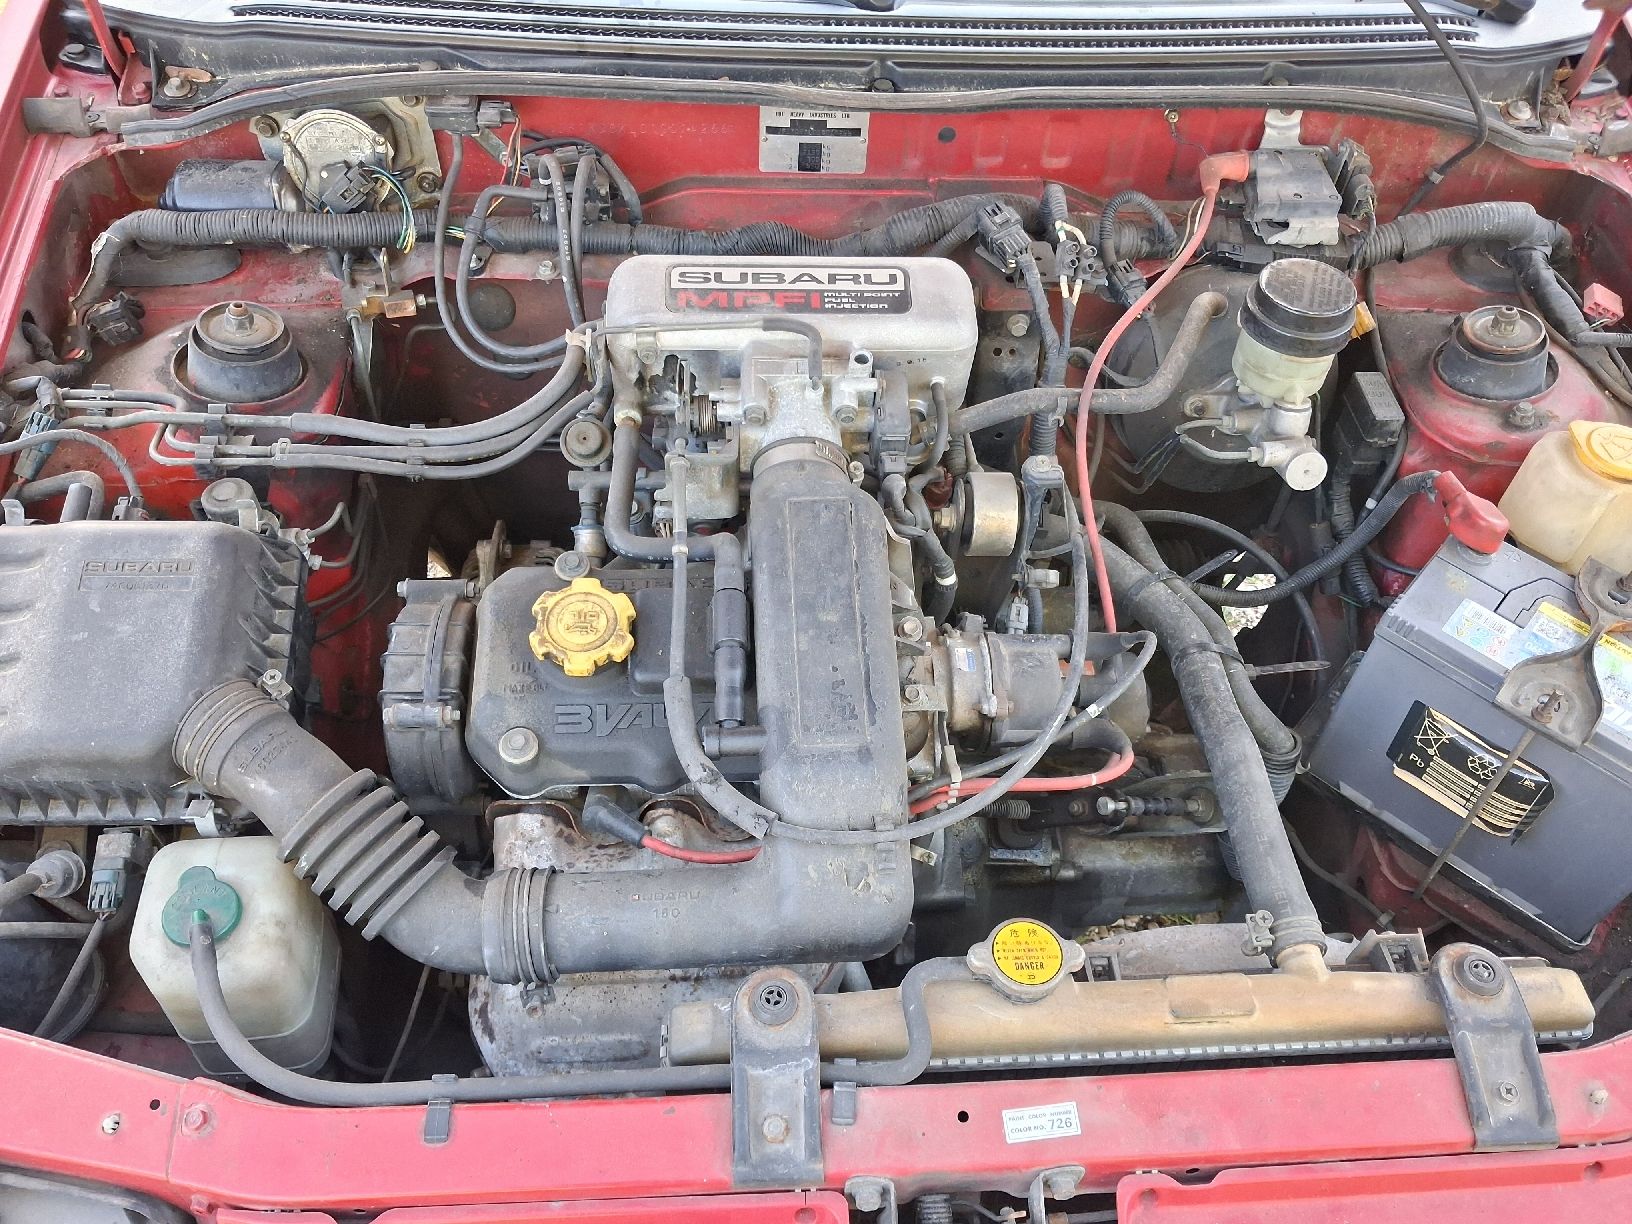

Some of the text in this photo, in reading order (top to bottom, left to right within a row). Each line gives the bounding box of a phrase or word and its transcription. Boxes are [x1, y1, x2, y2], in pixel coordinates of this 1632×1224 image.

[677, 271, 898, 286] SUBARU
[676, 290, 822, 310] MPFI
[84, 560, 194, 573] SUBARU
[1409, 752, 1425, 768] Pb
[1014, 961, 1045, 971] DANGER
[1010, 1125, 1032, 1134] COLOR
[1047, 1117, 1073, 1130] 726
